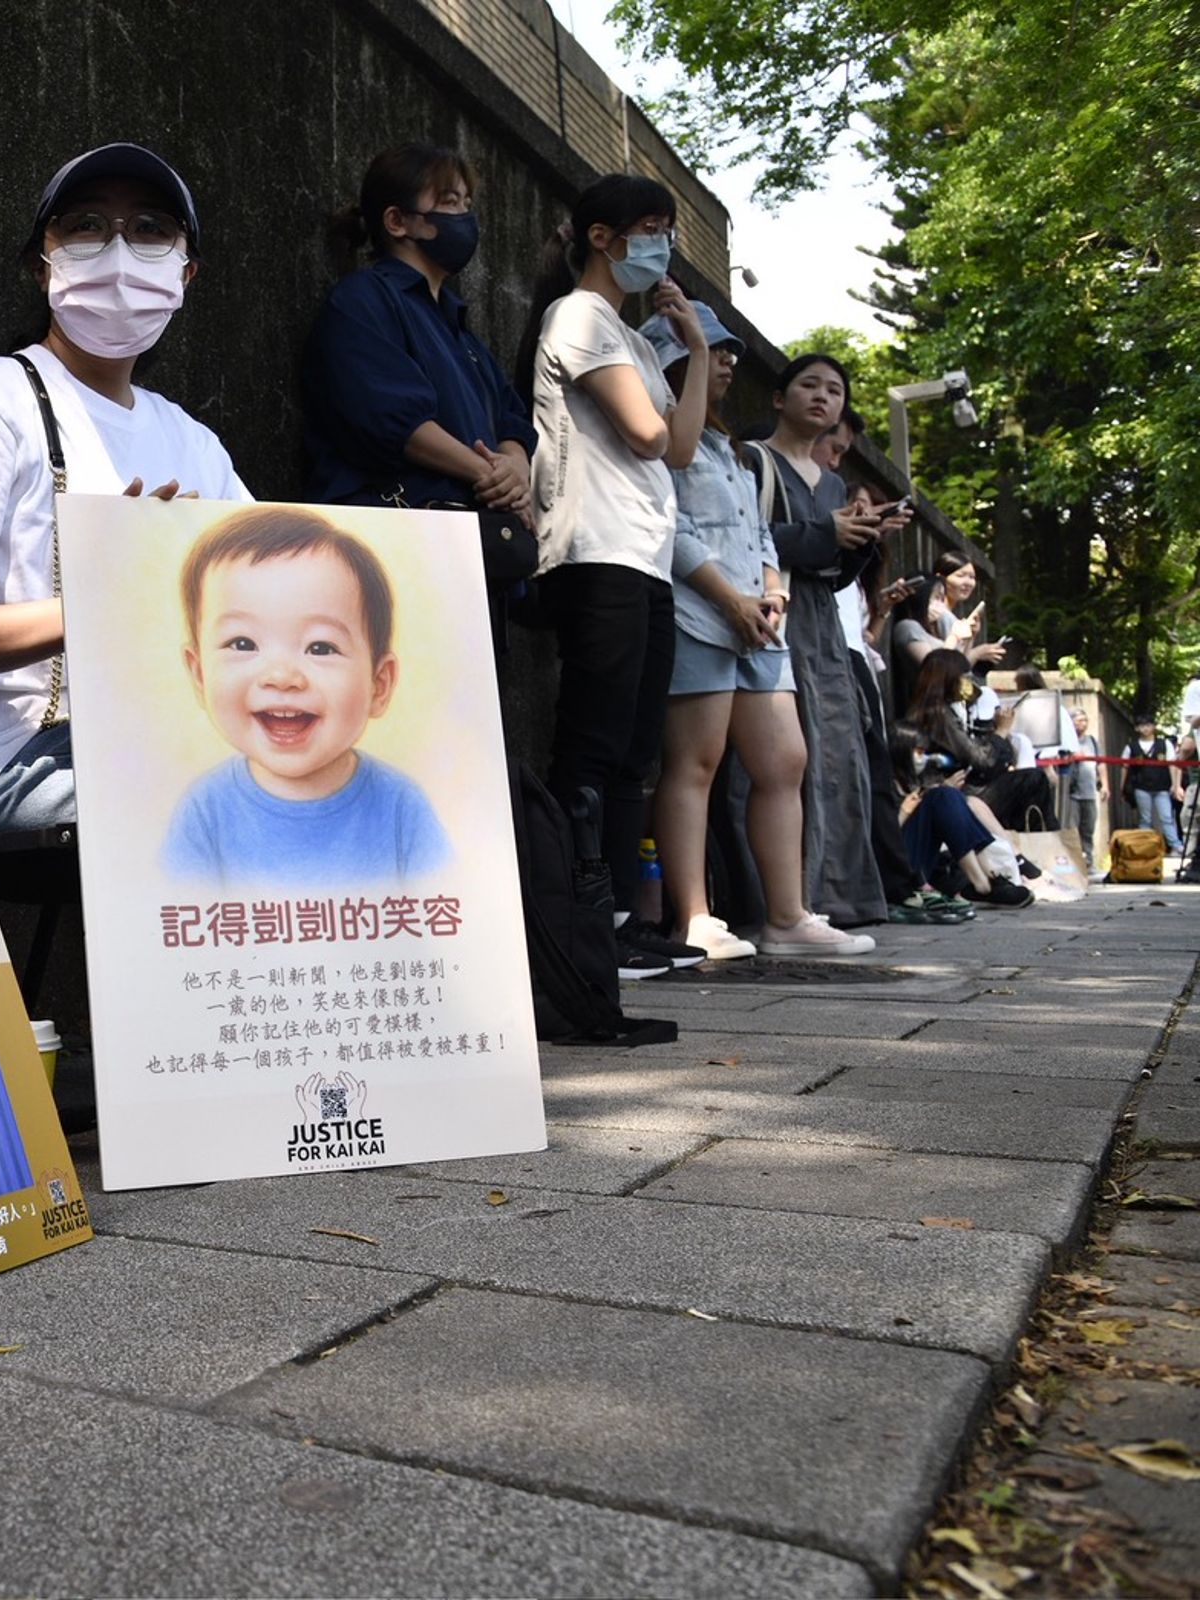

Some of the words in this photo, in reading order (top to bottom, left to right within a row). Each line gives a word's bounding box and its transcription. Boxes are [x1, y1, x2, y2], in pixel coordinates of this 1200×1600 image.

[159, 894, 464, 948] 記得剴剴的笑容
[287, 1118, 384, 1146] JUSTICE
[287, 1145, 322, 1163] FOR
[325, 1142, 354, 1159] KAI
[357, 1139, 386, 1156] KAI
[41, 1199, 86, 1229] JUSTICE
[43, 1225, 61, 1241] FOR
[60, 1219, 76, 1235] KAI
[74, 1214, 89, 1230] KAI
